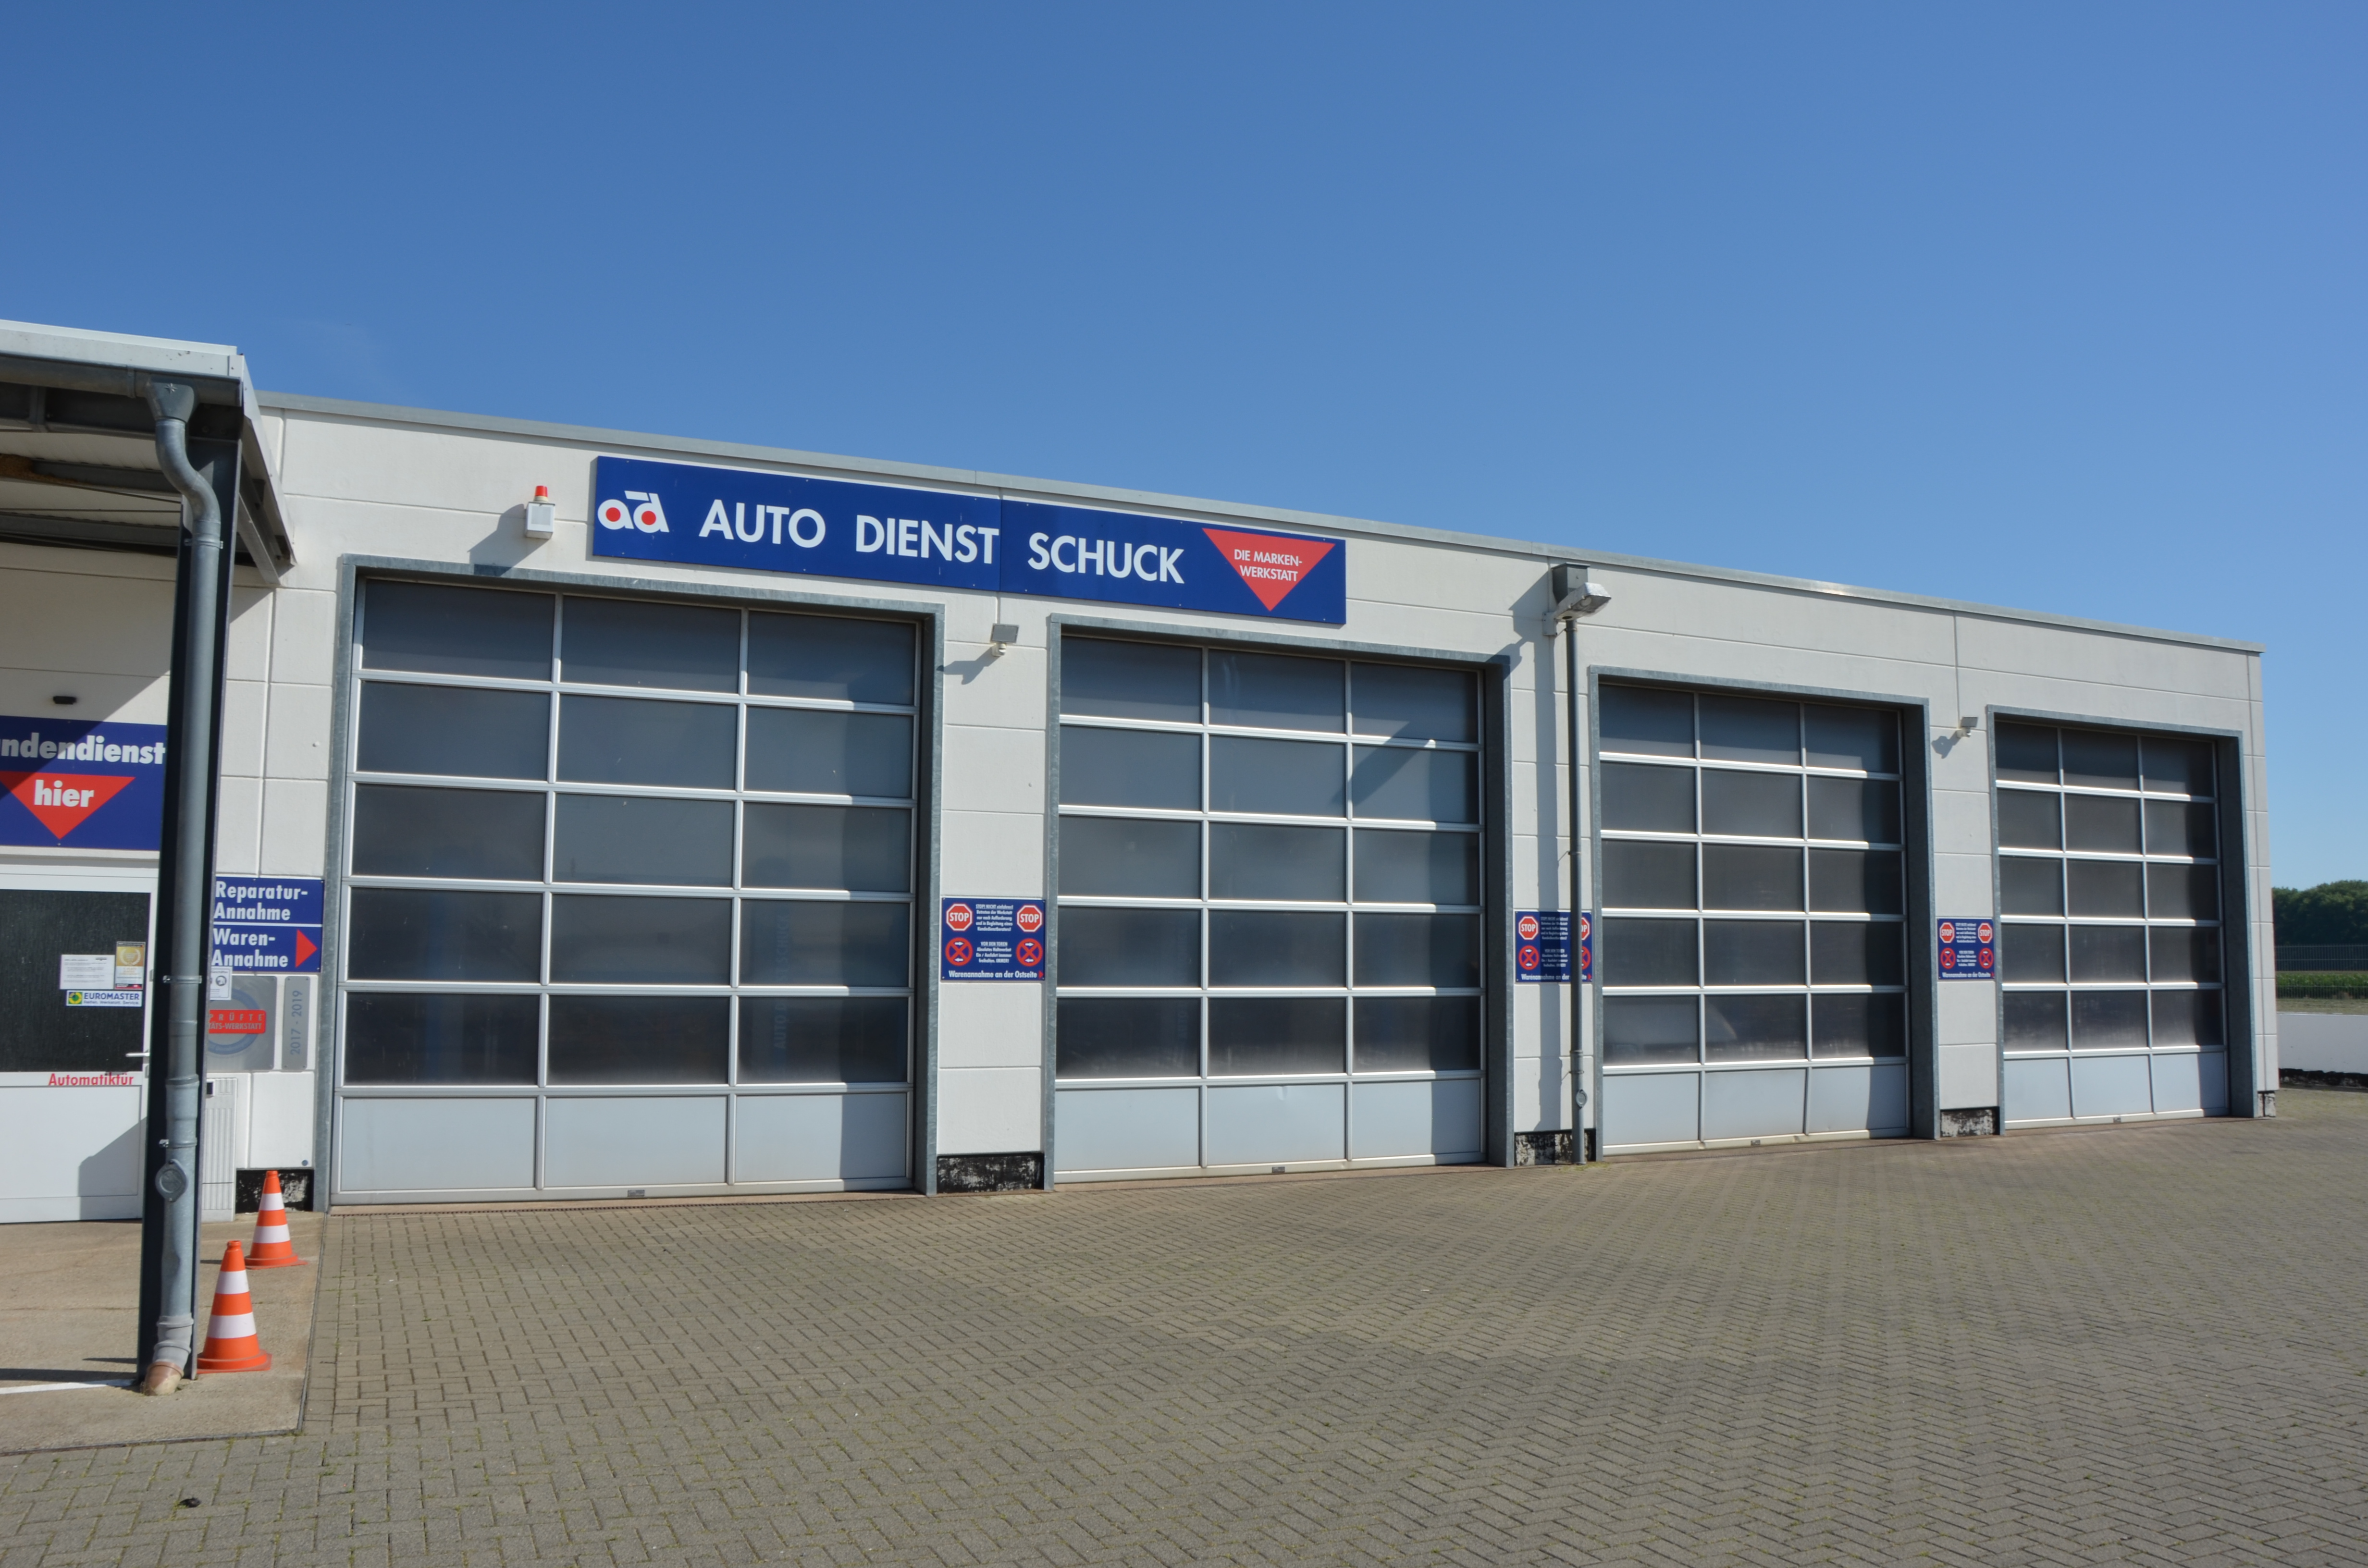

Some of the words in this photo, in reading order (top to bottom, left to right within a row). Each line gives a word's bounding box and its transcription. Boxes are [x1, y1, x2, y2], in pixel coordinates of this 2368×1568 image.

[698, 499, 826, 548] AUTO
[856, 514, 999, 564] DIENST
[1027, 532, 1185, 584] SCHUCK
[1234, 549, 1250, 561] DIE
[1253, 551, 1303, 567] MARKEN-
[1239, 564, 1298, 582] WERKSTATT
[0, 732, 166, 764] ndendienst
[34, 779, 94, 808] hier
[215, 881, 308, 903] Reparatur-
[213, 902, 291, 921] Annahme
[950, 912, 970, 922] STOP
[1020, 914, 1039, 923] STOP
[212, 928, 276, 946] Waren-
[1521, 924, 1536, 932] STOP
[211, 949, 288, 968] Annahme
[292, 990, 303, 1017] 2019
[209, 1012, 262, 1021] PRÜFTE
[209, 1021, 262, 1029] TÄTS-WERKSTATT
[290, 1029, 300, 1055] 2017
[48, 1072, 134, 1086] Automatiktür
